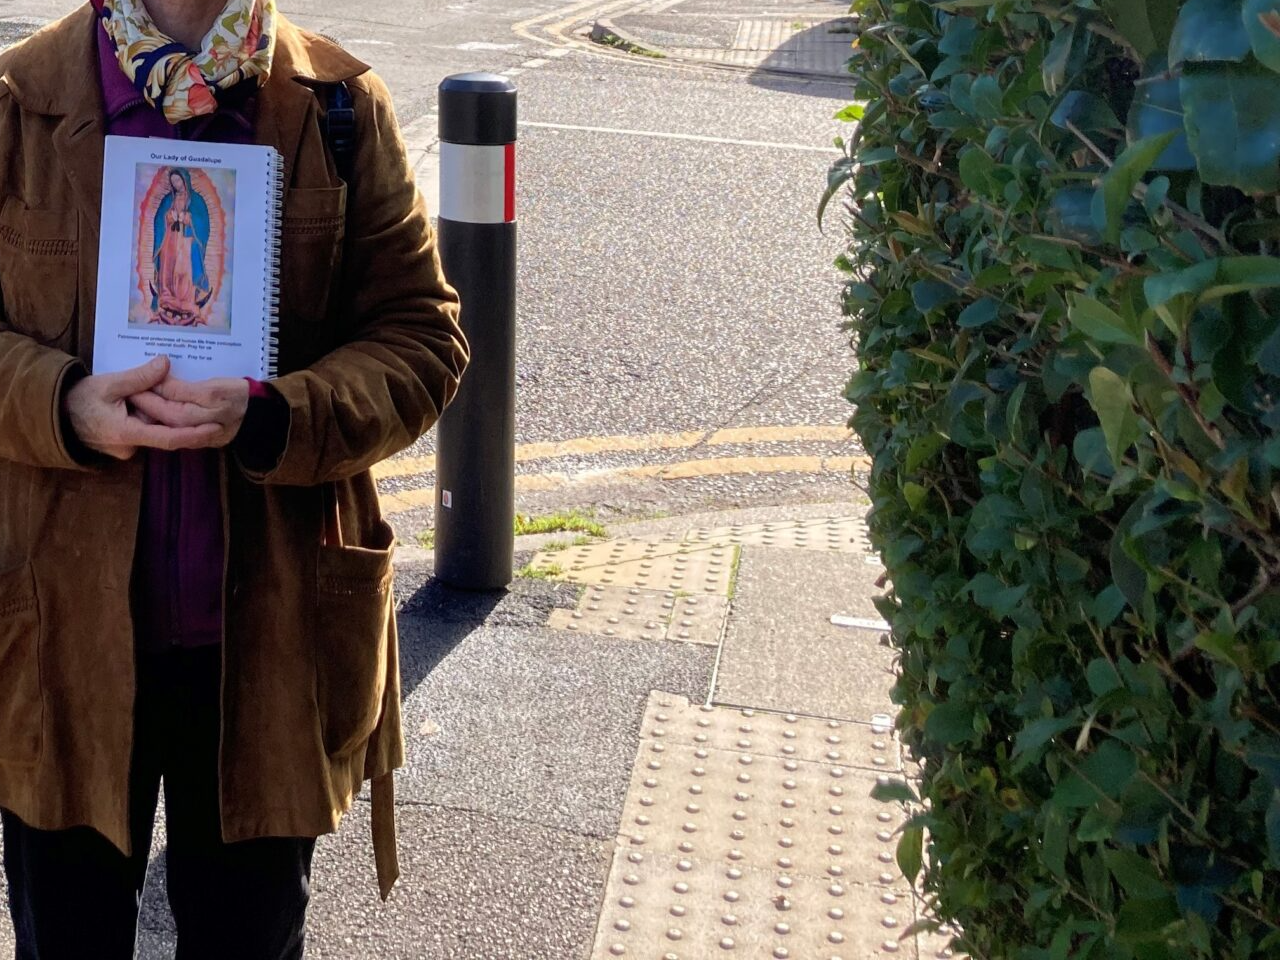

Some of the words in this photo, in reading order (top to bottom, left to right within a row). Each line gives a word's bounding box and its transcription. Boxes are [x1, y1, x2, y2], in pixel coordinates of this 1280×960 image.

[150, 152, 162, 160] Our
[163, 153, 179, 162] Lady
[188, 155, 222, 164] Guadalupe
